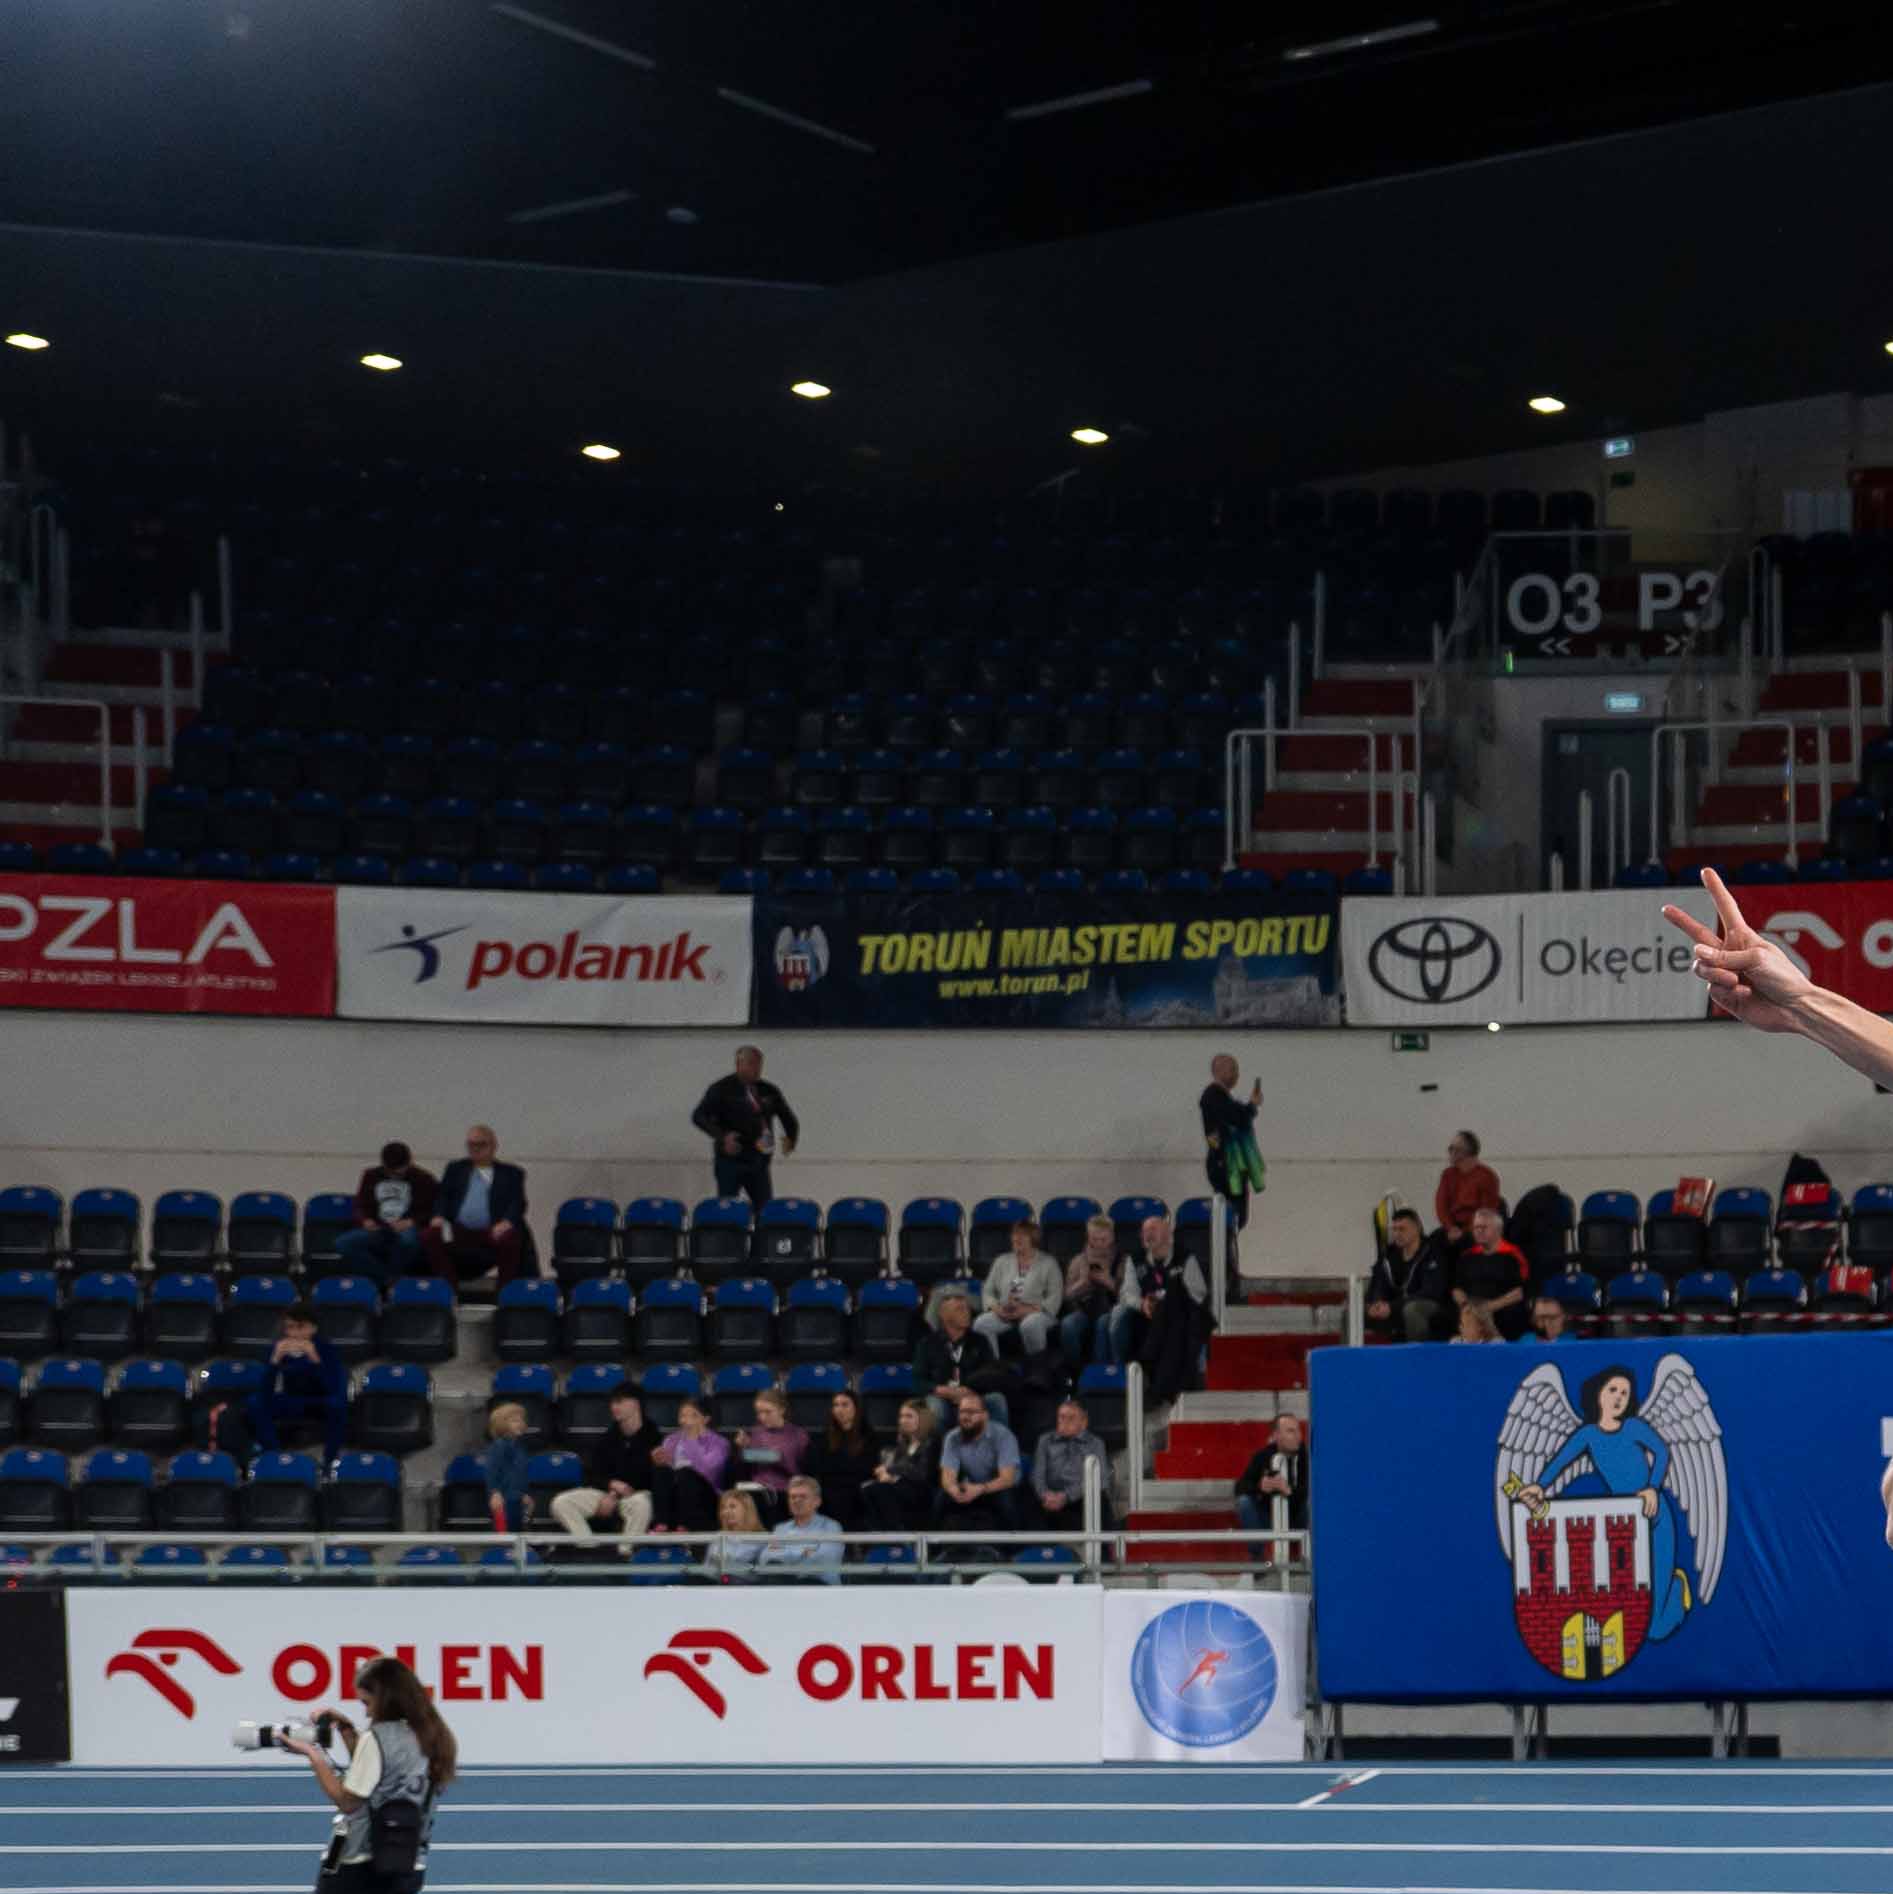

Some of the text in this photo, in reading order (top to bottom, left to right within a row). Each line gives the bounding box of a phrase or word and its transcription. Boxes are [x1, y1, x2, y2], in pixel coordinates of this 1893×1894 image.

[1639, 569, 1725, 632] P3
[466, 930, 712, 990] polanik
[858, 915, 1331, 975] TORUŃ MIASTEM SPORTU
[1540, 936, 1692, 984] Okęcie
[939, 968, 1089, 998] www.torun.pl
[271, 1643, 544, 1702] OREN
[797, 1643, 1054, 1702] ORLEN
